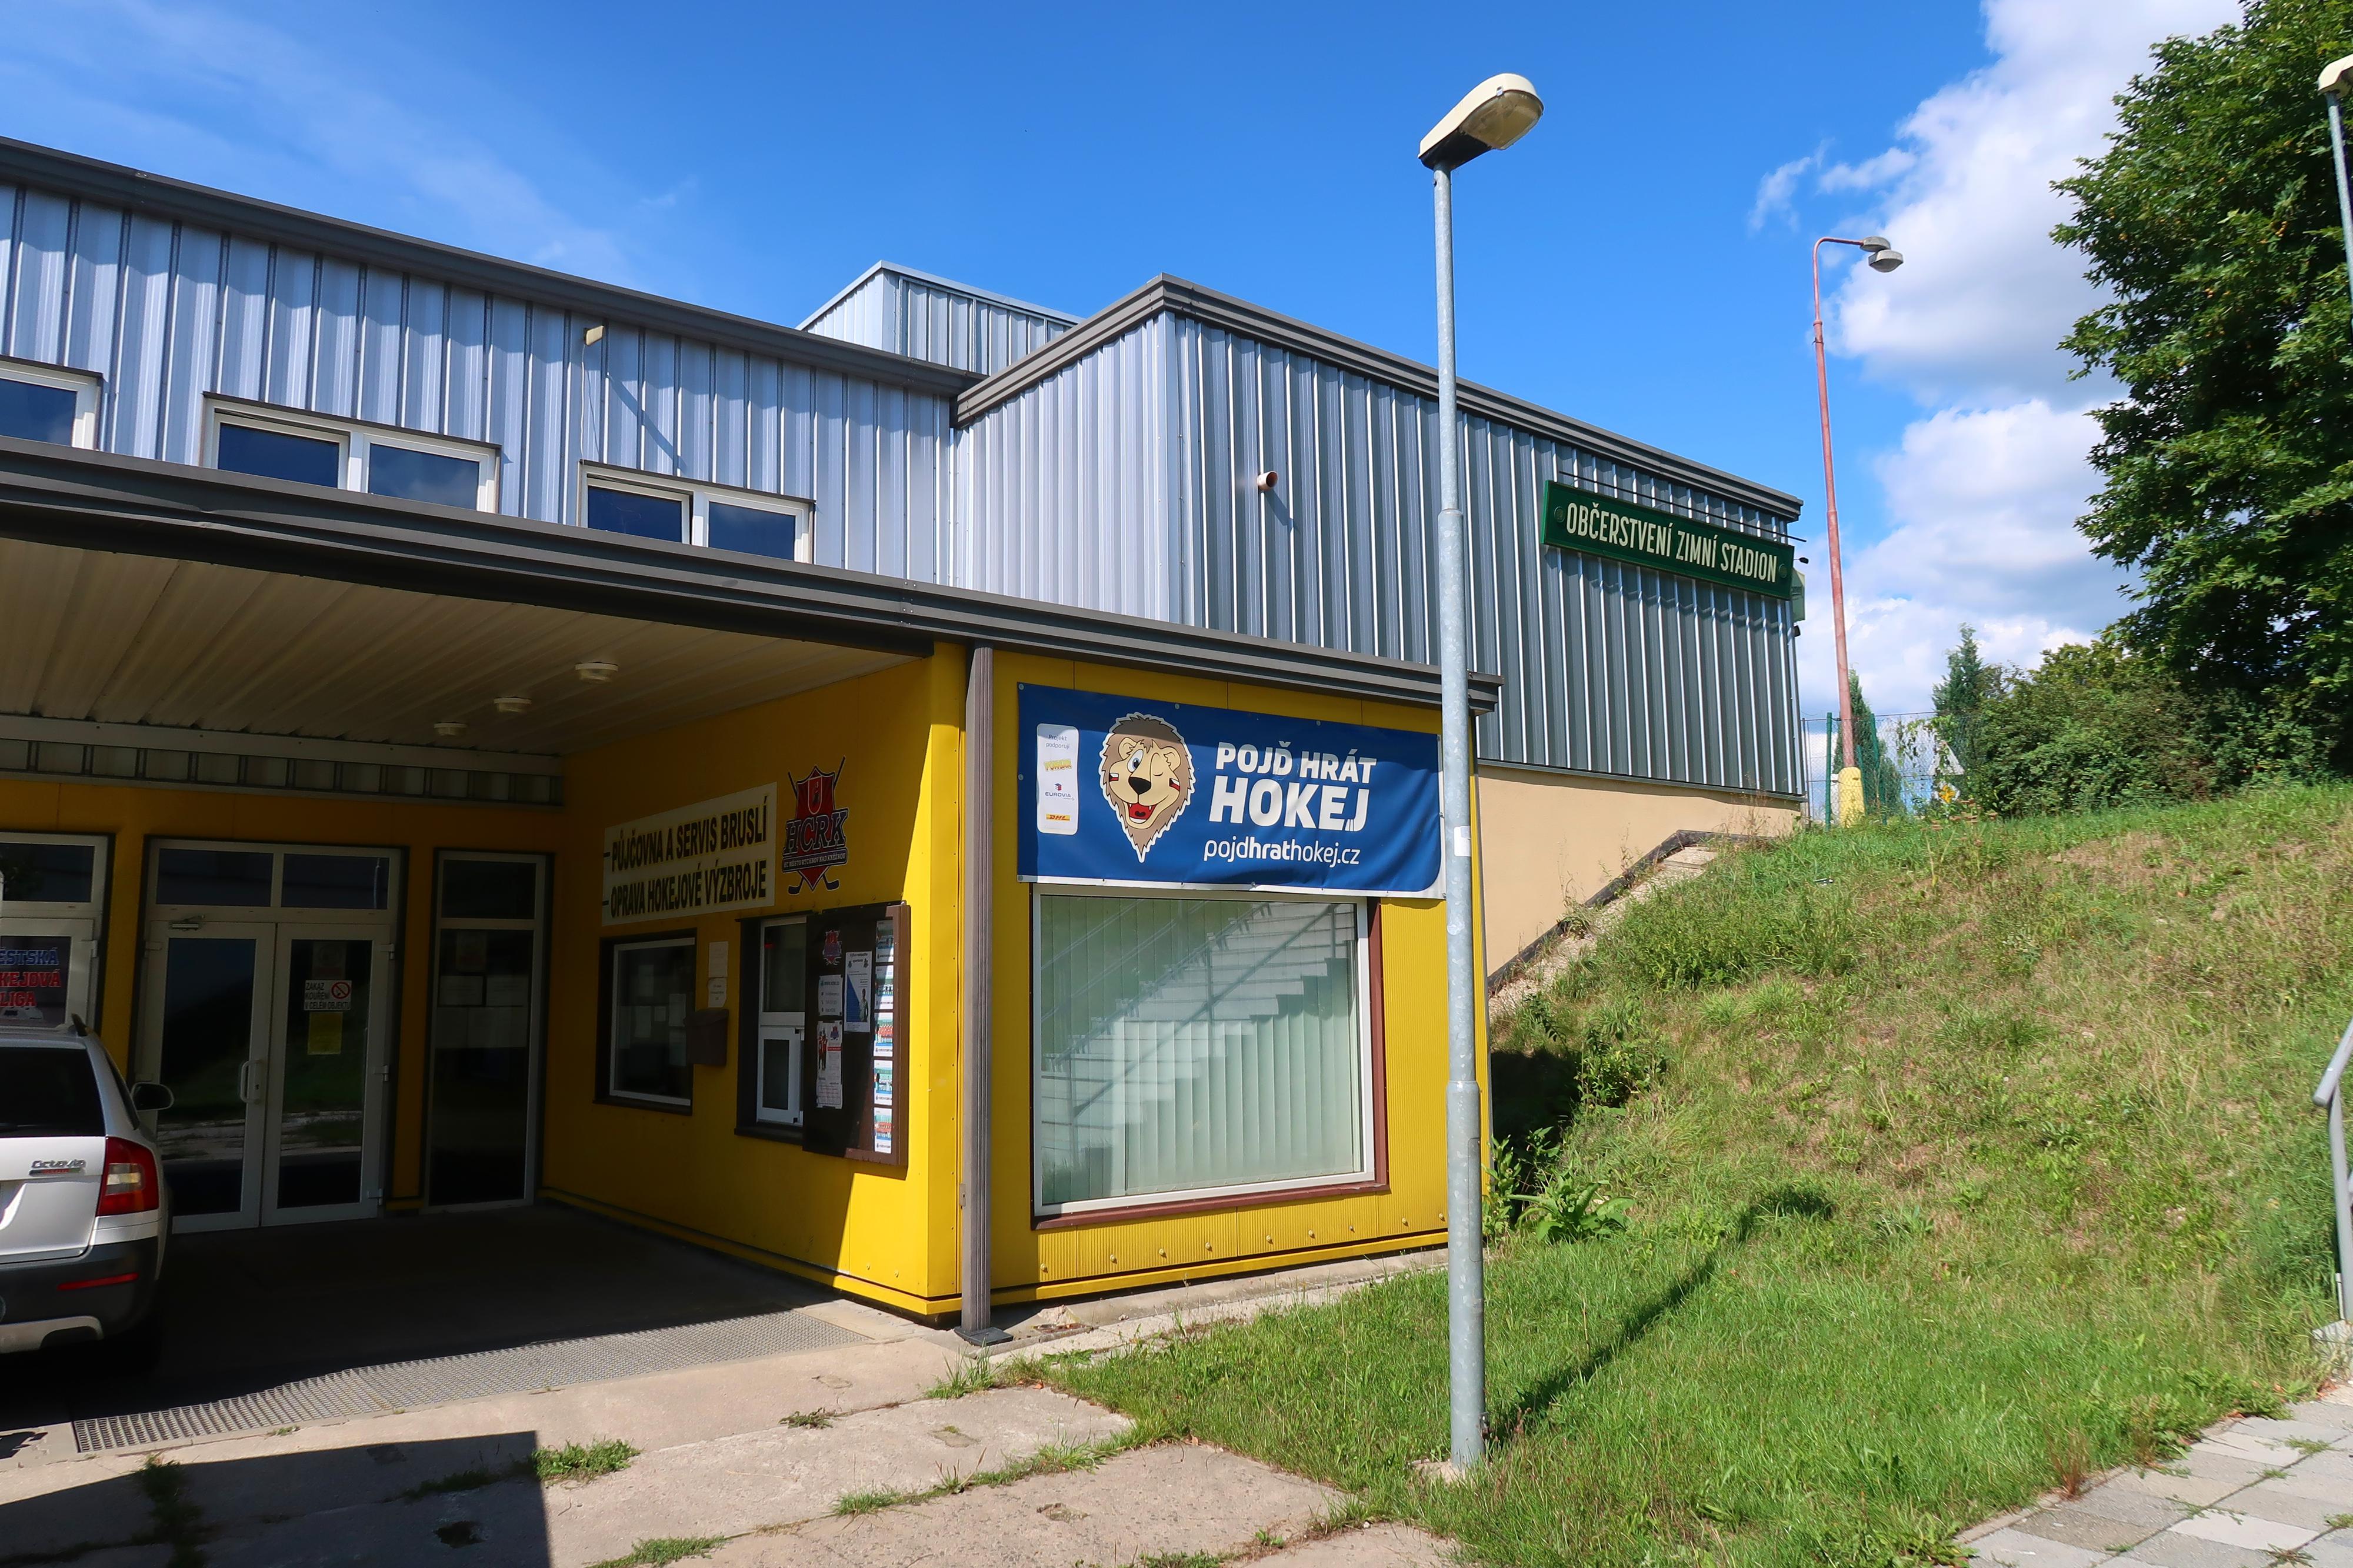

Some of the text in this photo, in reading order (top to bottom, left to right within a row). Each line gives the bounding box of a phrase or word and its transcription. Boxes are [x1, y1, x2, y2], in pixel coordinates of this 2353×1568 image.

[1565, 502, 1778, 583] OBČERSTVENÍ ZIMNÍ STADION
[1048, 734, 1067, 743] Projekt
[1215, 740, 1377, 784] POJĎ HRÁT
[1208, 775, 1370, 832] HOKEJ
[666, 830, 674, 860] A
[676, 816, 717, 859] SERVIS
[721, 795, 768, 850] BRUSLÍ
[782, 810, 848, 855] HCRK
[1204, 835, 1361, 868] pojdhrathokej.cz
[648, 862, 702, 913] HOKEJOVÉ
[705, 859, 766, 905] VÝZBROJE
[31, 1159, 86, 1169] Octavia
